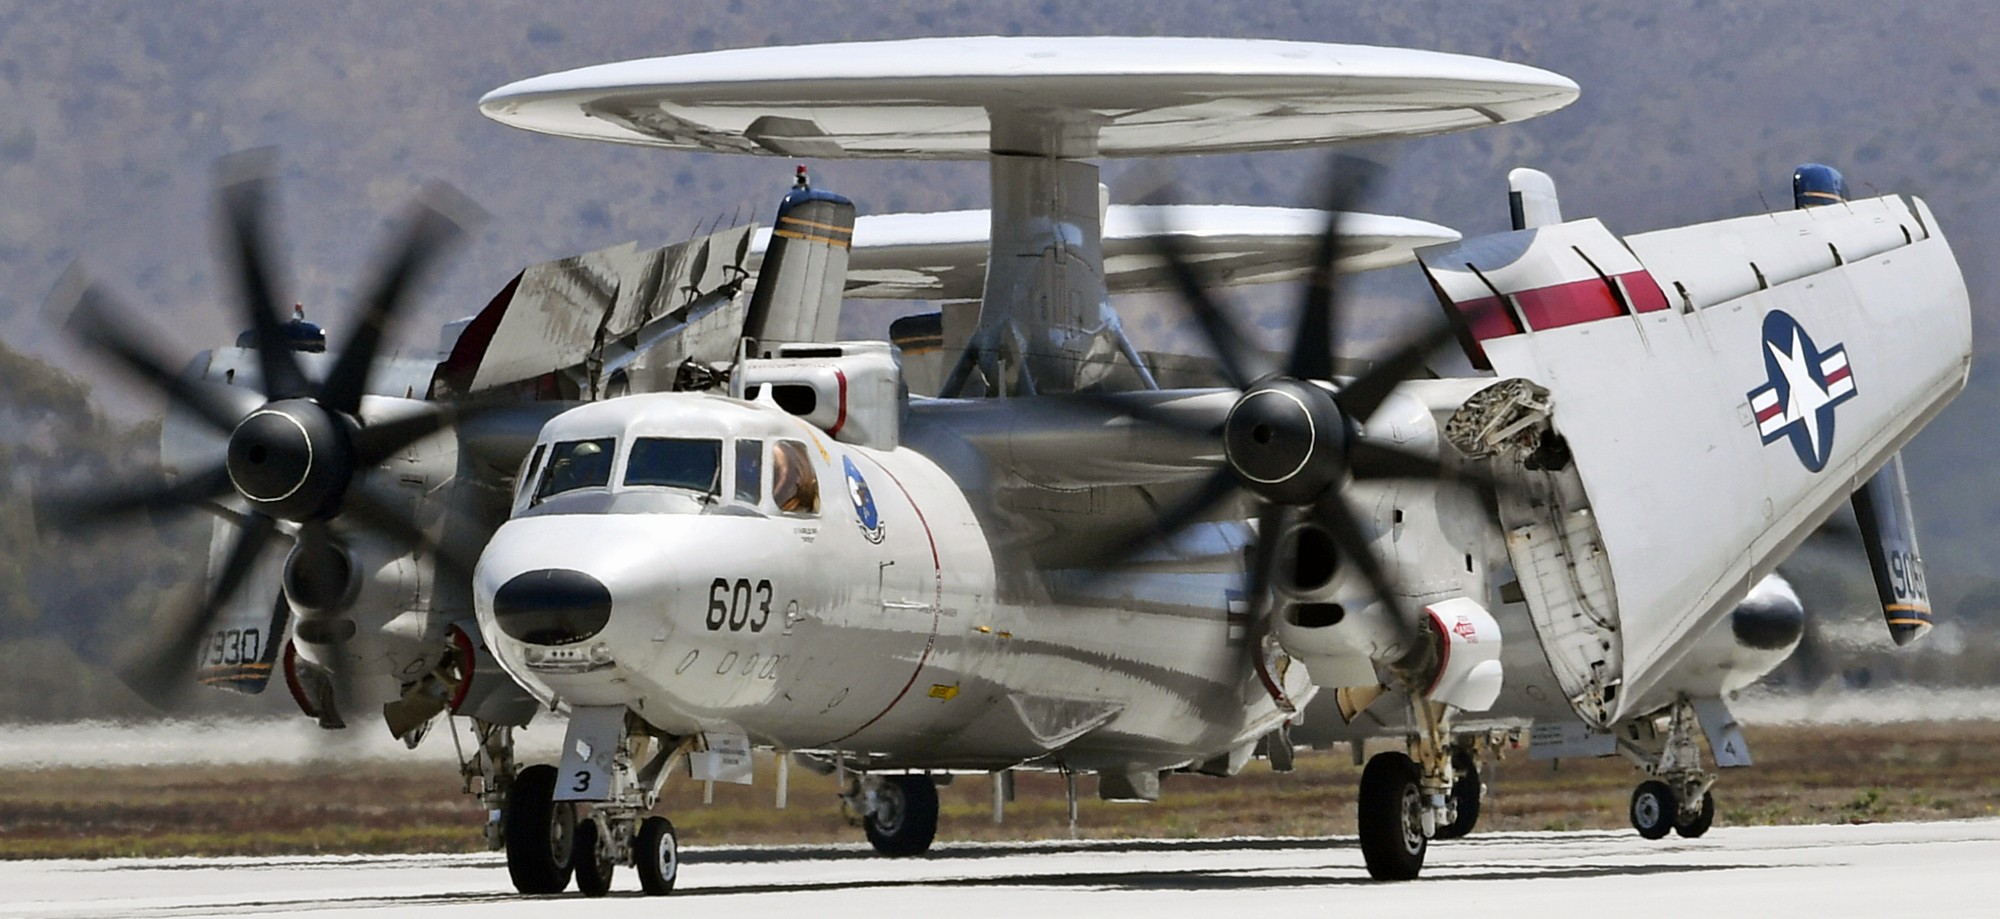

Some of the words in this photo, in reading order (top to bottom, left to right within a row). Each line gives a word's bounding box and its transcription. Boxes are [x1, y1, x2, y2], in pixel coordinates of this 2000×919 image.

[706, 577, 773, 633] 603
[1725, 741, 1737, 757] 4
[572, 771, 591, 792] 3
